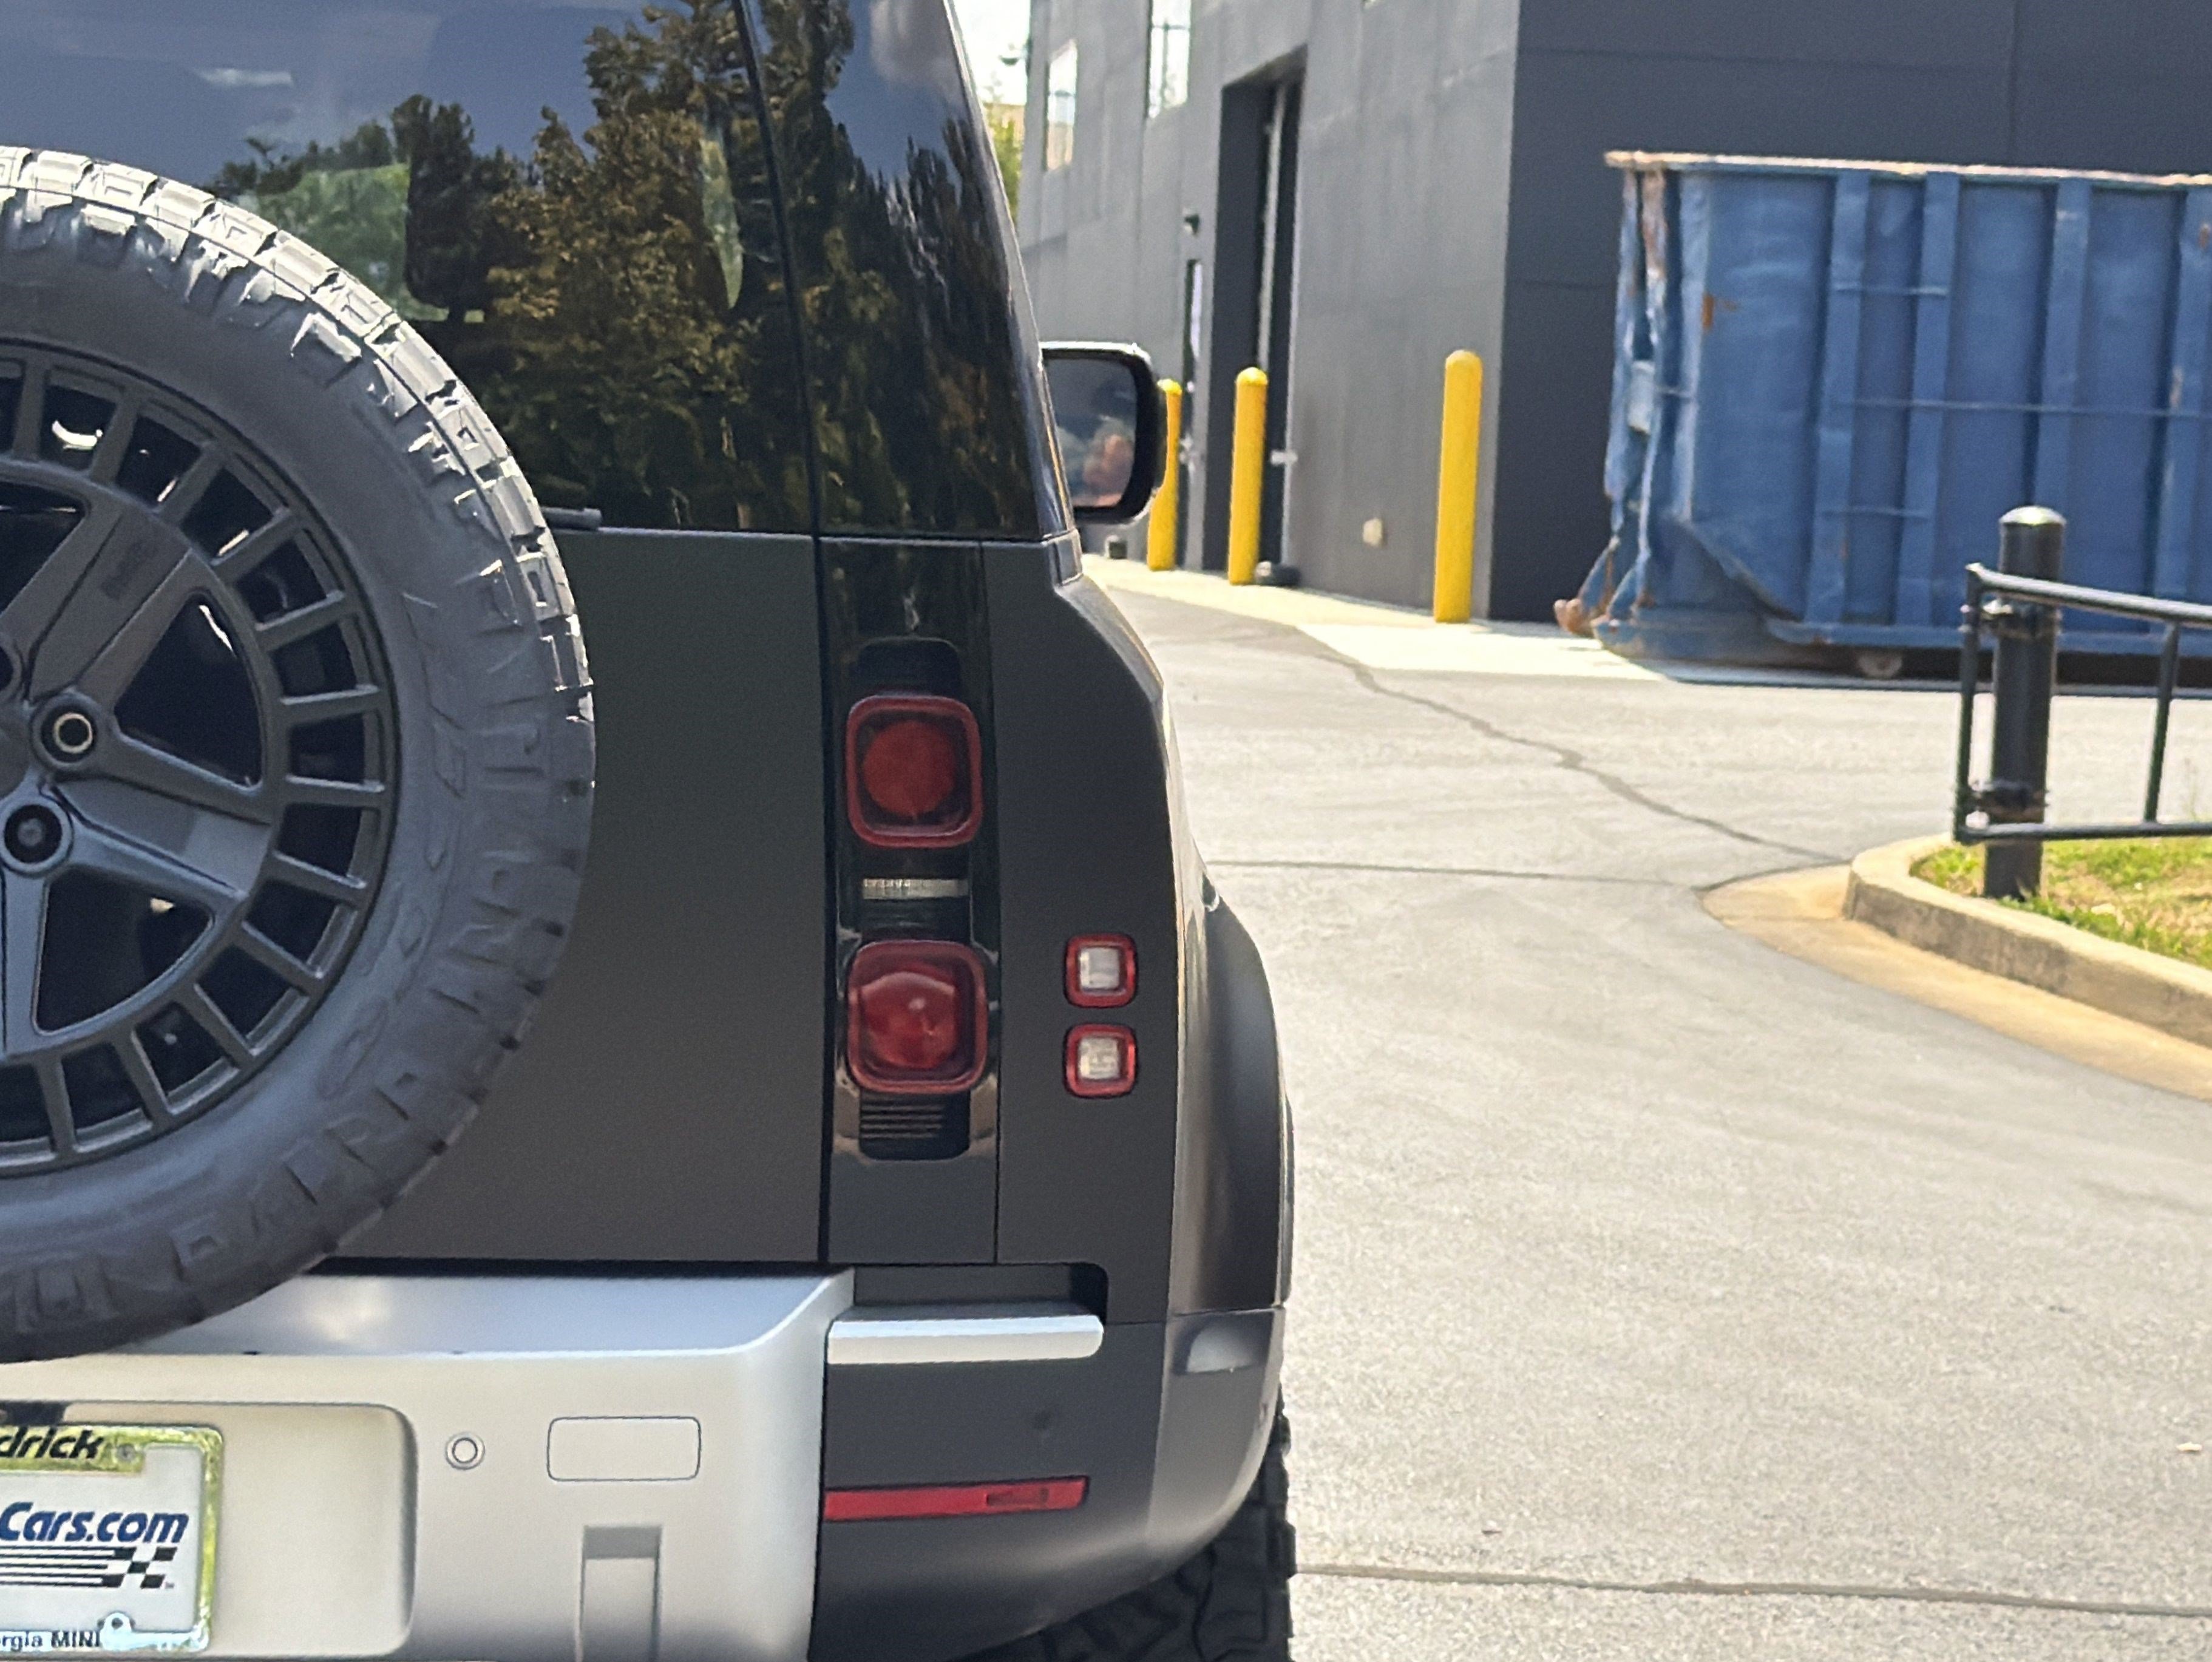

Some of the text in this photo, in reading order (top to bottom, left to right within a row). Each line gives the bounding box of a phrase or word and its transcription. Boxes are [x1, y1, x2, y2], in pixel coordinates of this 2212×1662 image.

[0, 1502, 189, 1543] Cars.com
[0, 1630, 101, 1652] rgia MINI
